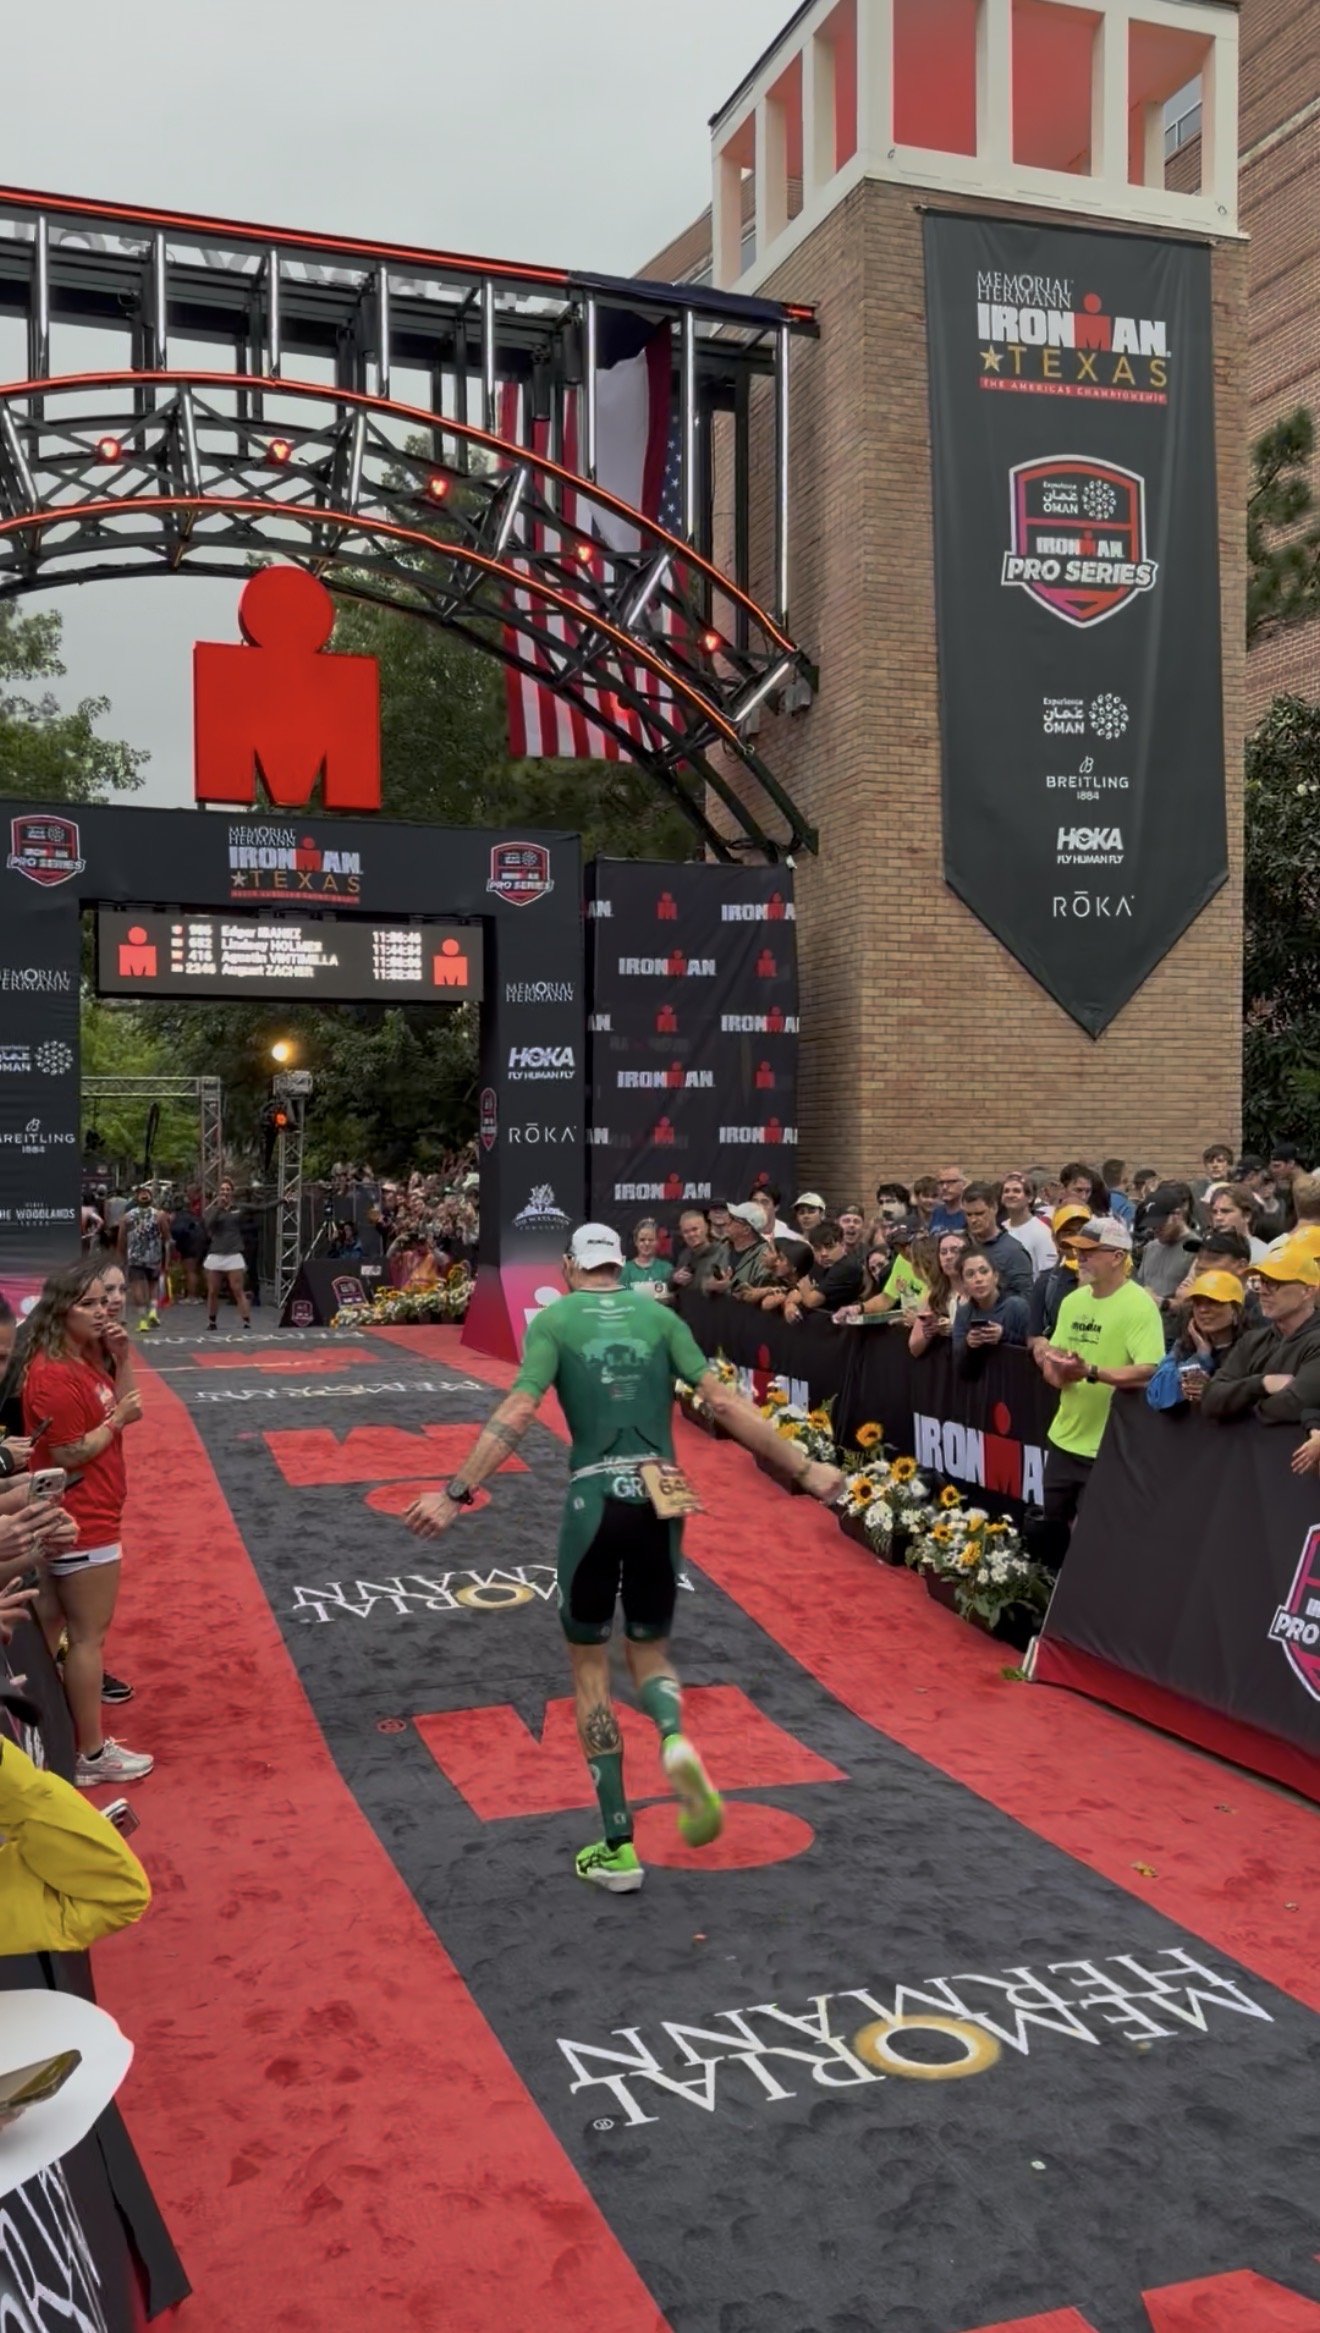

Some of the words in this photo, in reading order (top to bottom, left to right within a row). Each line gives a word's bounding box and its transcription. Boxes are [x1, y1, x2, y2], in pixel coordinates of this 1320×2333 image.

[977, 270, 1072, 295] MEMORIAL
[977, 285, 1072, 309] HERMANN
[977, 293, 1169, 357] IRONMAN
[1007, 345, 1168, 388] TEXAS
[983, 378, 1005, 390] THE
[1011, 381, 1072, 395] AMERICAS
[1076, 387, 1167, 403] CHAMPIONSHIP
[1043, 502, 1079, 515] OMAN
[1036, 530, 1124, 558] IRONMAN
[1007, 558, 1061, 581] PRO
[1064, 560, 1152, 586] SERIES
[1043, 721, 1085, 734] OMAN
[1046, 775, 1129, 788] BREITLING
[1076, 790, 1100, 800] 1884
[229, 826, 296, 839] MEMORIAL
[229, 834, 296, 848] HERMANN
[1056, 827, 1124, 851] HOKA
[229, 837, 363, 875] IRONMAN
[1056, 854, 1072, 864] FLY
[1073, 854, 1108, 864] HUMAN
[1109, 854, 1124, 864] FLY
[252, 870, 361, 893] TEXAS
[721, 892, 796, 921] IRONMA
[0, 968, 69, 982] EMORIAL
[618, 949, 716, 977] IRONMAN
[0, 978, 70, 991] ERMANN
[506, 981, 575, 994] MEMORIAL
[506, 990, 574, 1003] HERMANN
[721, 1006, 799, 1033] IRONMA
[0, 1062, 31, 1072] MAN
[508, 1047, 576, 1068] HOKA
[617, 1061, 715, 1088] IRONMAN
[0, 1133, 76, 1144] REITLING
[719, 1117, 798, 1144] IRONMA
[614, 1173, 712, 1200] IRONMAN
[16, 1208, 76, 1220] WOODLANDS
[914, 1402, 1049, 1507] IRONMA
[1274, 1611, 1320, 1645] PRO
[556, 1947, 1237, 2085] HERMANN
[569, 1990, 1274, 2127] MEMORIAL
